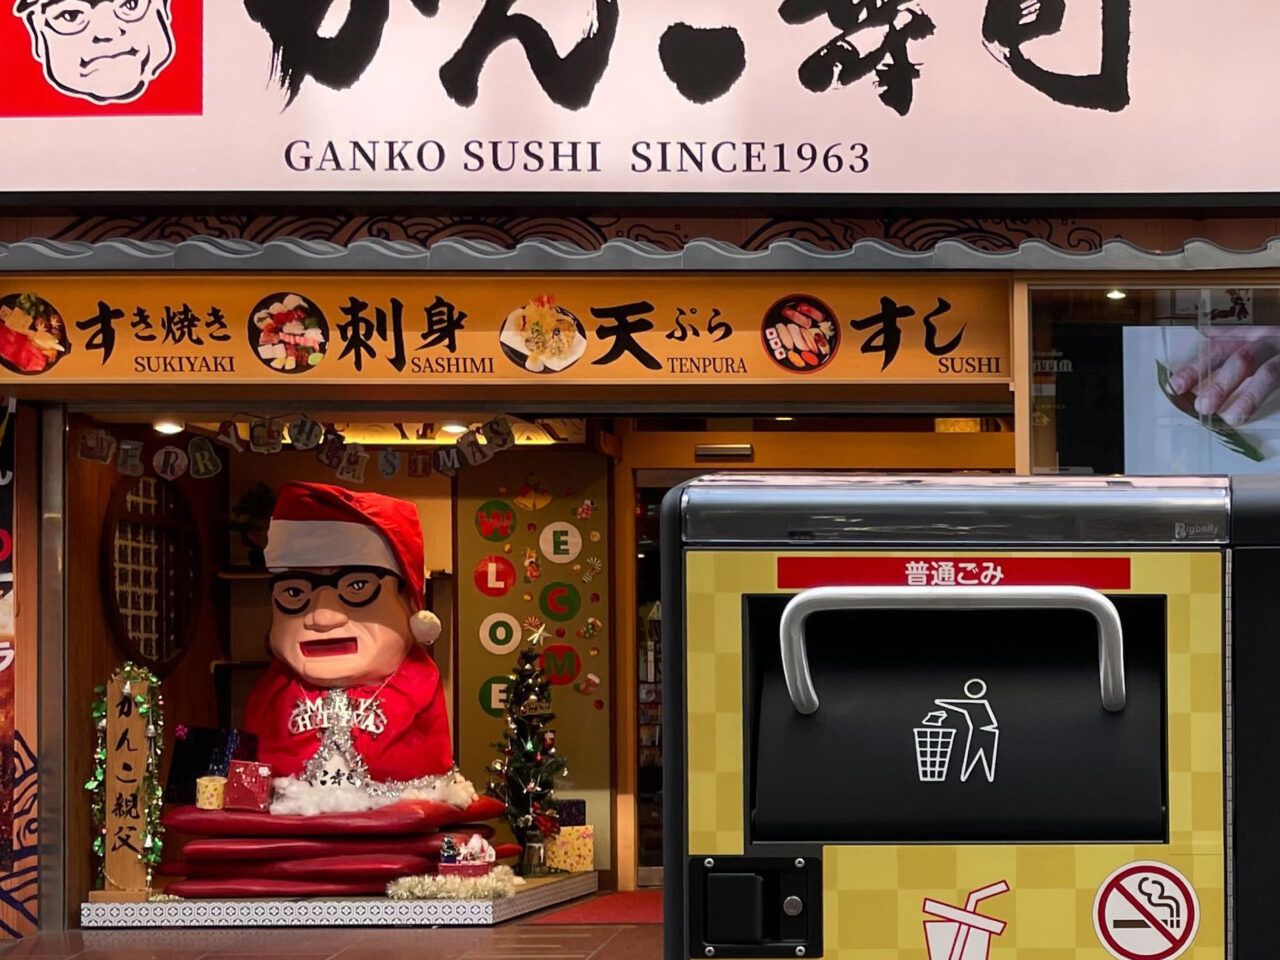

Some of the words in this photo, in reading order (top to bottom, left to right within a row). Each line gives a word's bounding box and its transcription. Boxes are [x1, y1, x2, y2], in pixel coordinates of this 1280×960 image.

[285, 140, 446, 174] GANKO
[463, 140, 601, 174] SUSHI
[631, 140, 869, 174] SINCE1963
[75, 300, 234, 367] すき焼き
[336, 295, 467, 373] 刺身
[590, 300, 735, 371] 天ぷら
[849, 295, 971, 372] すし
[134, 355, 236, 373] SUKIYAKI
[411, 356, 495, 373] SASHIMI
[667, 356, 747, 374] TENPURA
[937, 356, 1002, 374] SUSHI
[1175, 522, 1219, 538] Bigbelly
[905, 560, 1004, 586] 普通ごみ
